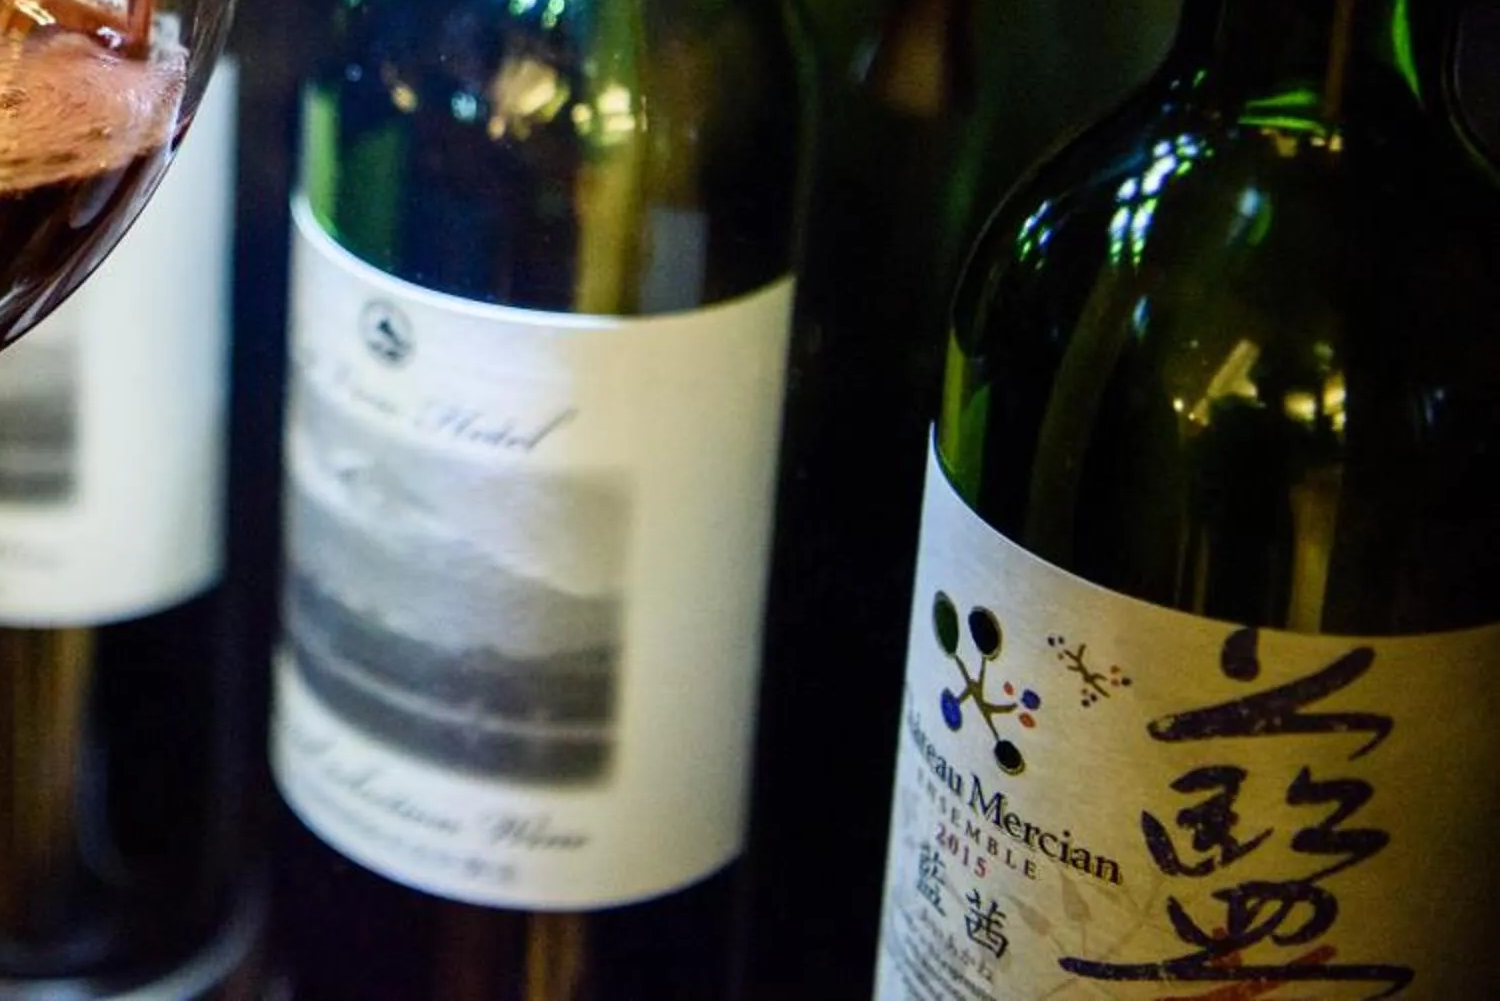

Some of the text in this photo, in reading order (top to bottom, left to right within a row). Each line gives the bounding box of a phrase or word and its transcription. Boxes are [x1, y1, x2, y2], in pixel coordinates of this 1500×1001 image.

[918, 768, 1038, 881] ENSEMBLE
[935, 822, 988, 880] 2015
[969, 773, 1123, 886] Mercian
